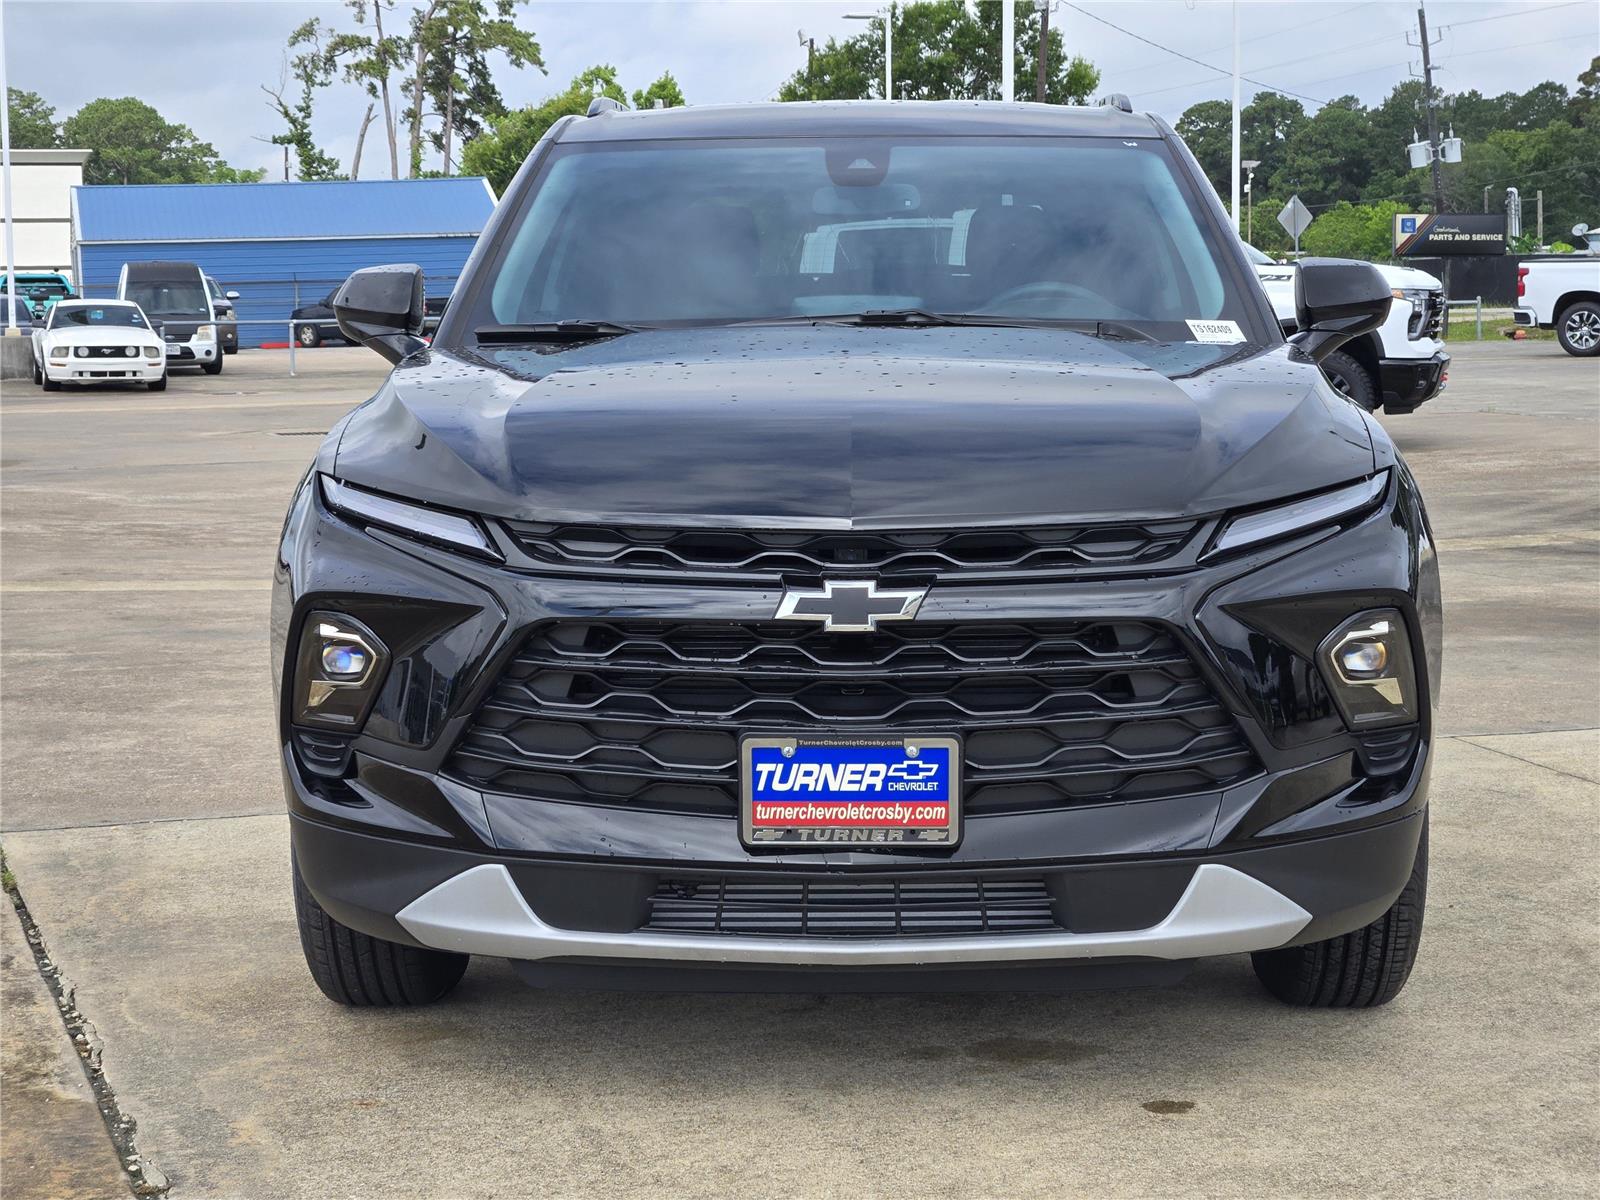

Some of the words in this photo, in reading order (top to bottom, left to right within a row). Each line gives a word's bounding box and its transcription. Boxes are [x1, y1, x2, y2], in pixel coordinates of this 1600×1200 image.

[755, 763, 888, 792] TURNER
[888, 782, 939, 791] CHEVROLET
[756, 803, 946, 824] turnerchevroletcrosby.com
[798, 829, 904, 841] TURNER
